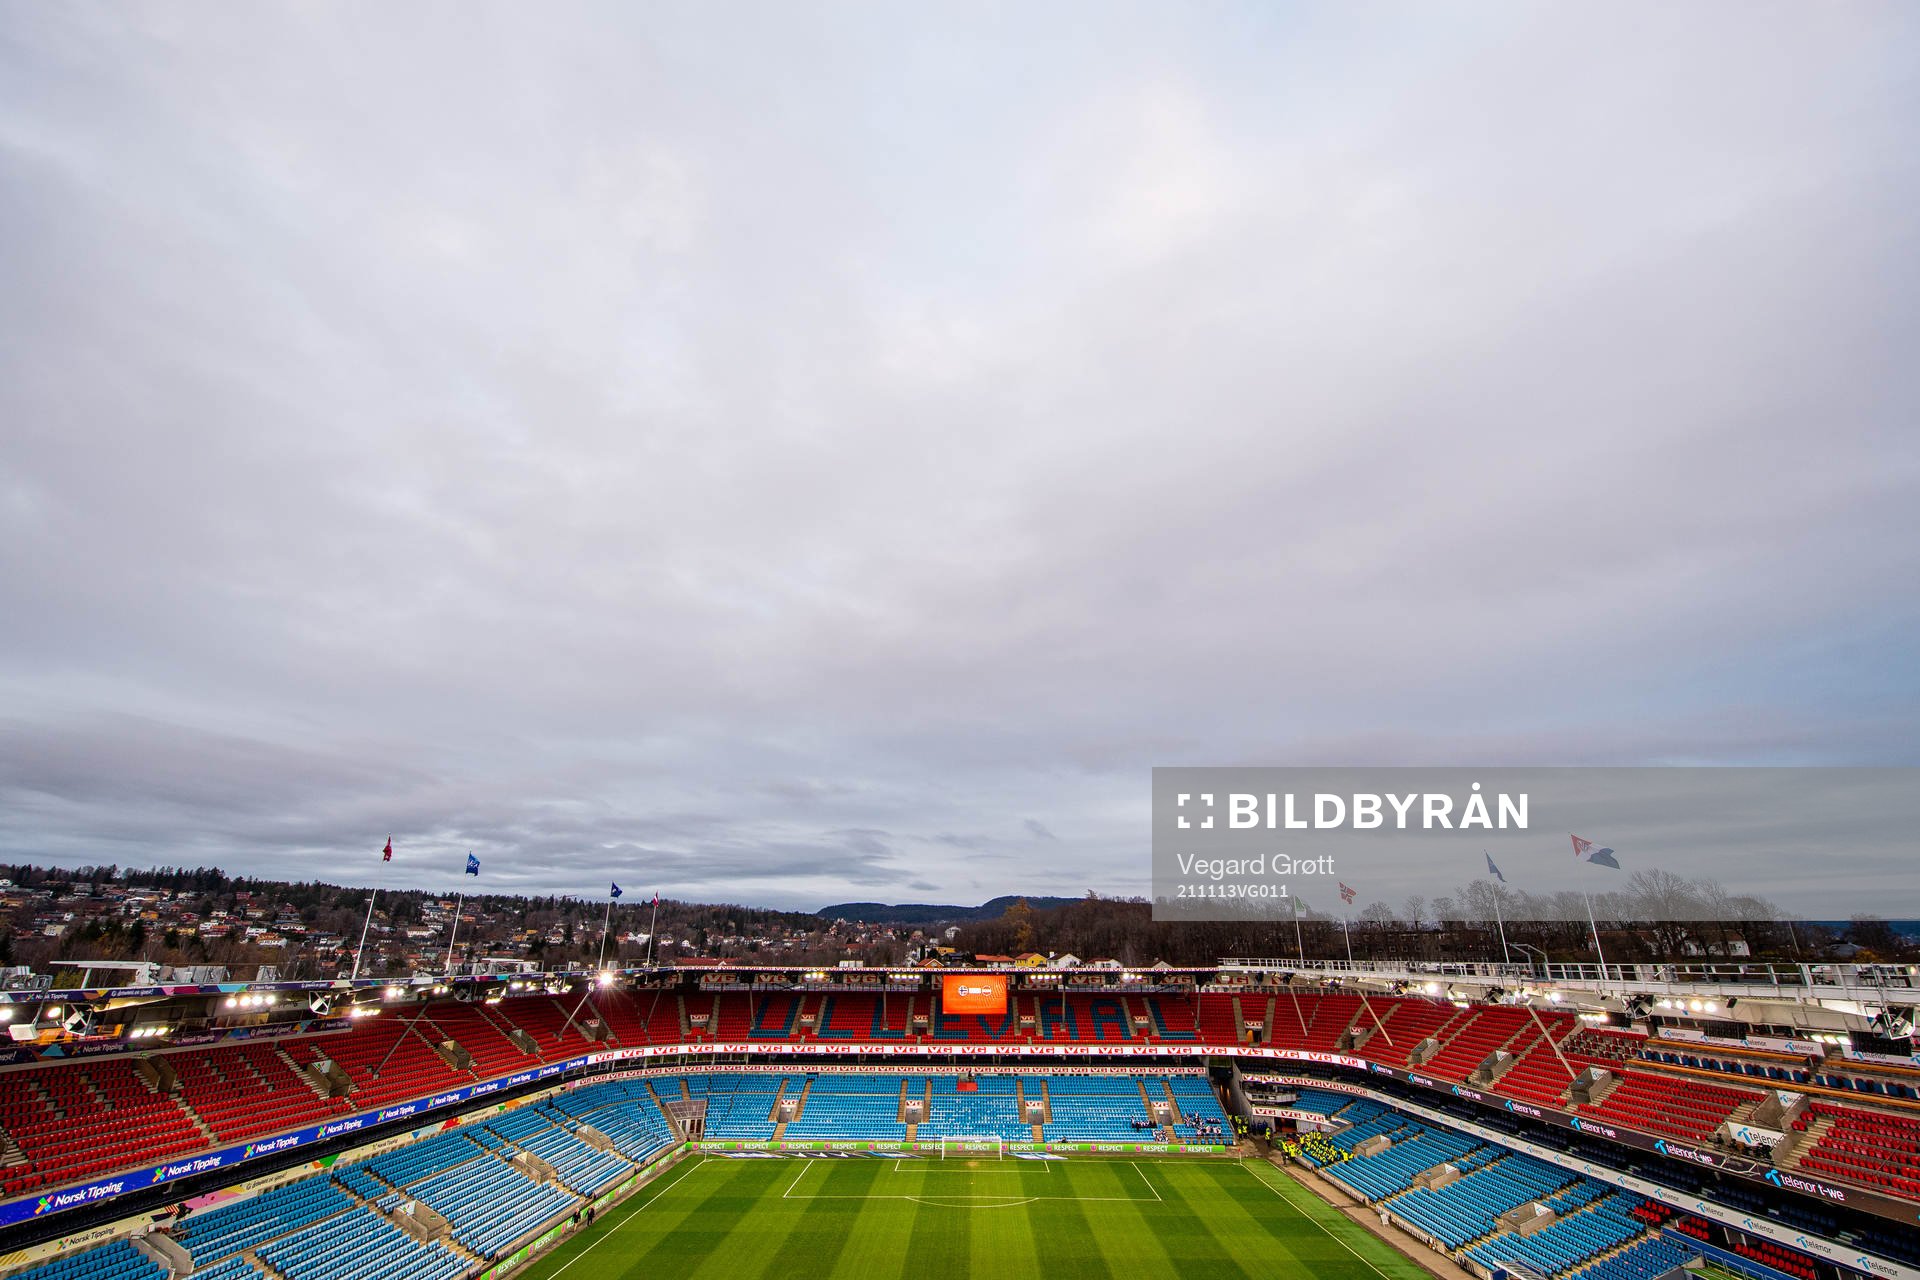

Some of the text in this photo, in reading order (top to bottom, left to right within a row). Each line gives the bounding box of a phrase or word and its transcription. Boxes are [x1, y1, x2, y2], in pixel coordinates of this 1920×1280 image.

[704, 973, 736, 983] VG
[758, 973, 787, 983] VG
[846, 975, 878, 984] VG
[1071, 975, 1103, 984] VG
[1161, 975, 1192, 984] VG
[621, 1049, 644, 1057] VG
[826, 1045, 850, 1053] VG
[1237, 1048, 1263, 1056] VG
[1273, 1050, 1299, 1058] VG
[595, 1052, 614, 1061] VG
[1308, 1052, 1332, 1061] VG
[1339, 1056, 1358, 1066] VG
[1255, 1108, 1276, 1116] VG
[1281, 1110, 1301, 1118] VG
[1306, 1113, 1325, 1121] VG
[326, 1119, 363, 1134] Norsk Tipping
[1580, 1120, 1616, 1138] telenor t-we
[1749, 1131, 1781, 1145] teleno
[255, 1135, 299, 1154] Norsk Tipping
[1666, 1143, 1693, 1160] telenor
[167, 1155, 222, 1177] Norsk Tipping
[1780, 1173, 1845, 1200] telenor t-we
[54, 1181, 124, 1207] Norsk Tipping
[1751, 1222, 1774, 1235] telenor
[69, 1226, 115, 1246] Norsk Tipping
[1805, 1241, 1832, 1255] telenor
[497, 1253, 521, 1275] RESPECT
[1868, 1261, 1898, 1277] telenor
